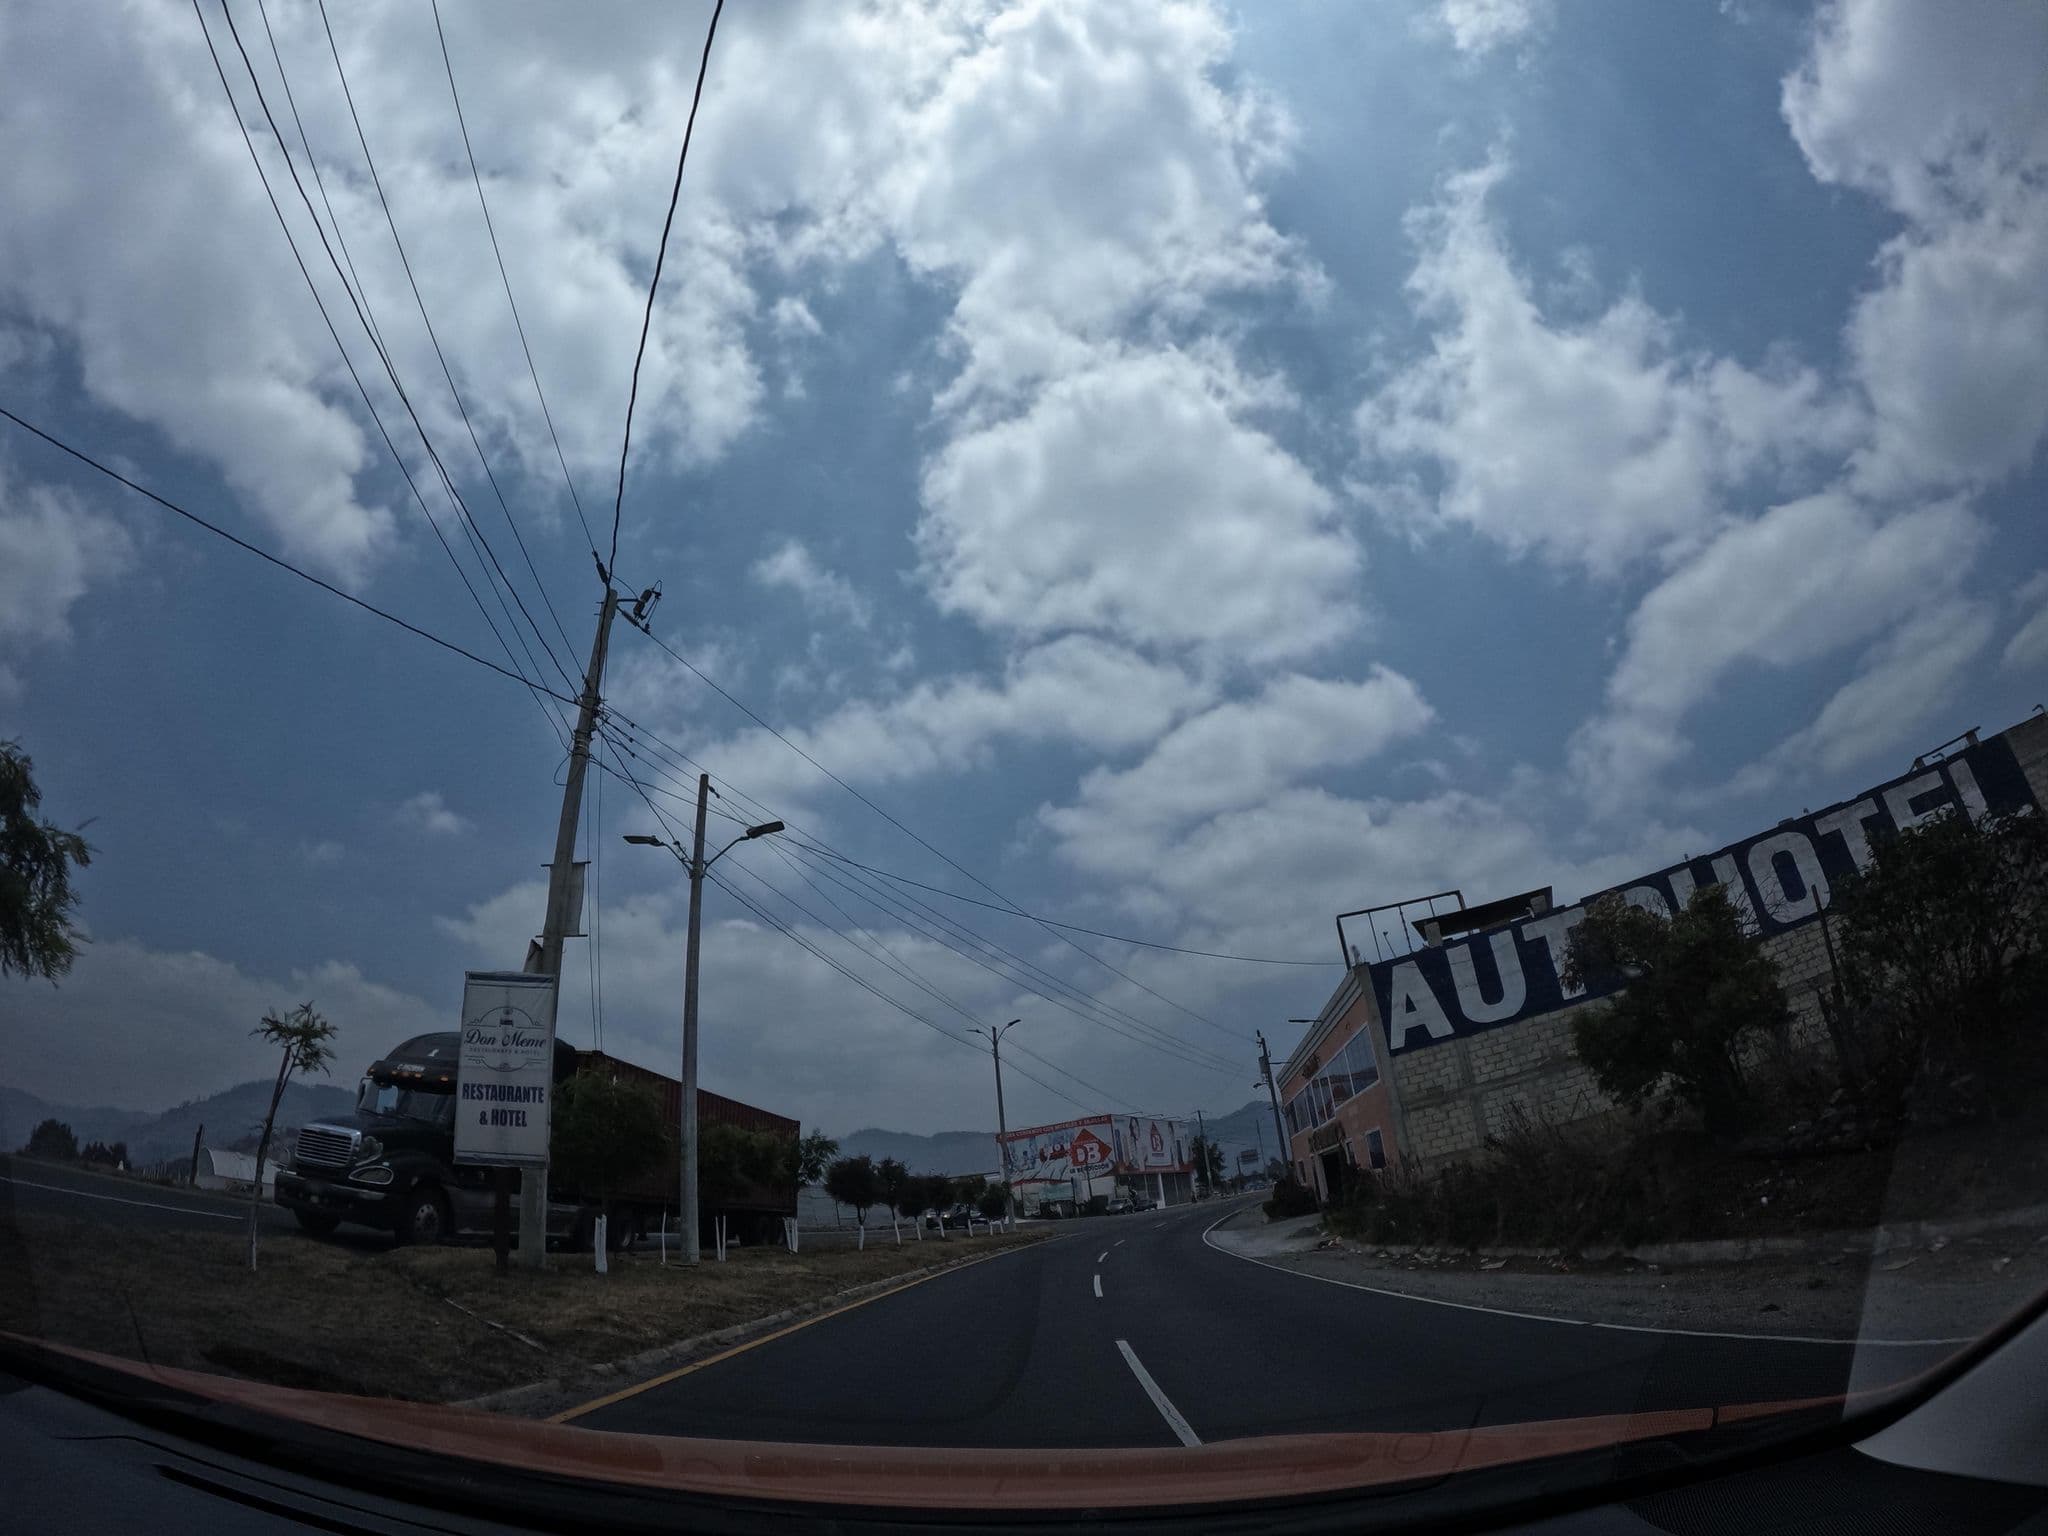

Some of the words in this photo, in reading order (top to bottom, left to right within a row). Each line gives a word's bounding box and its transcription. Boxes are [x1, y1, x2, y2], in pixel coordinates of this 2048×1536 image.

[464, 1029, 496, 1046] Don
[462, 1083, 544, 1103] RESTAURANTE
[479, 1111, 488, 1126] &
[491, 1109, 527, 1128] HOTEL
